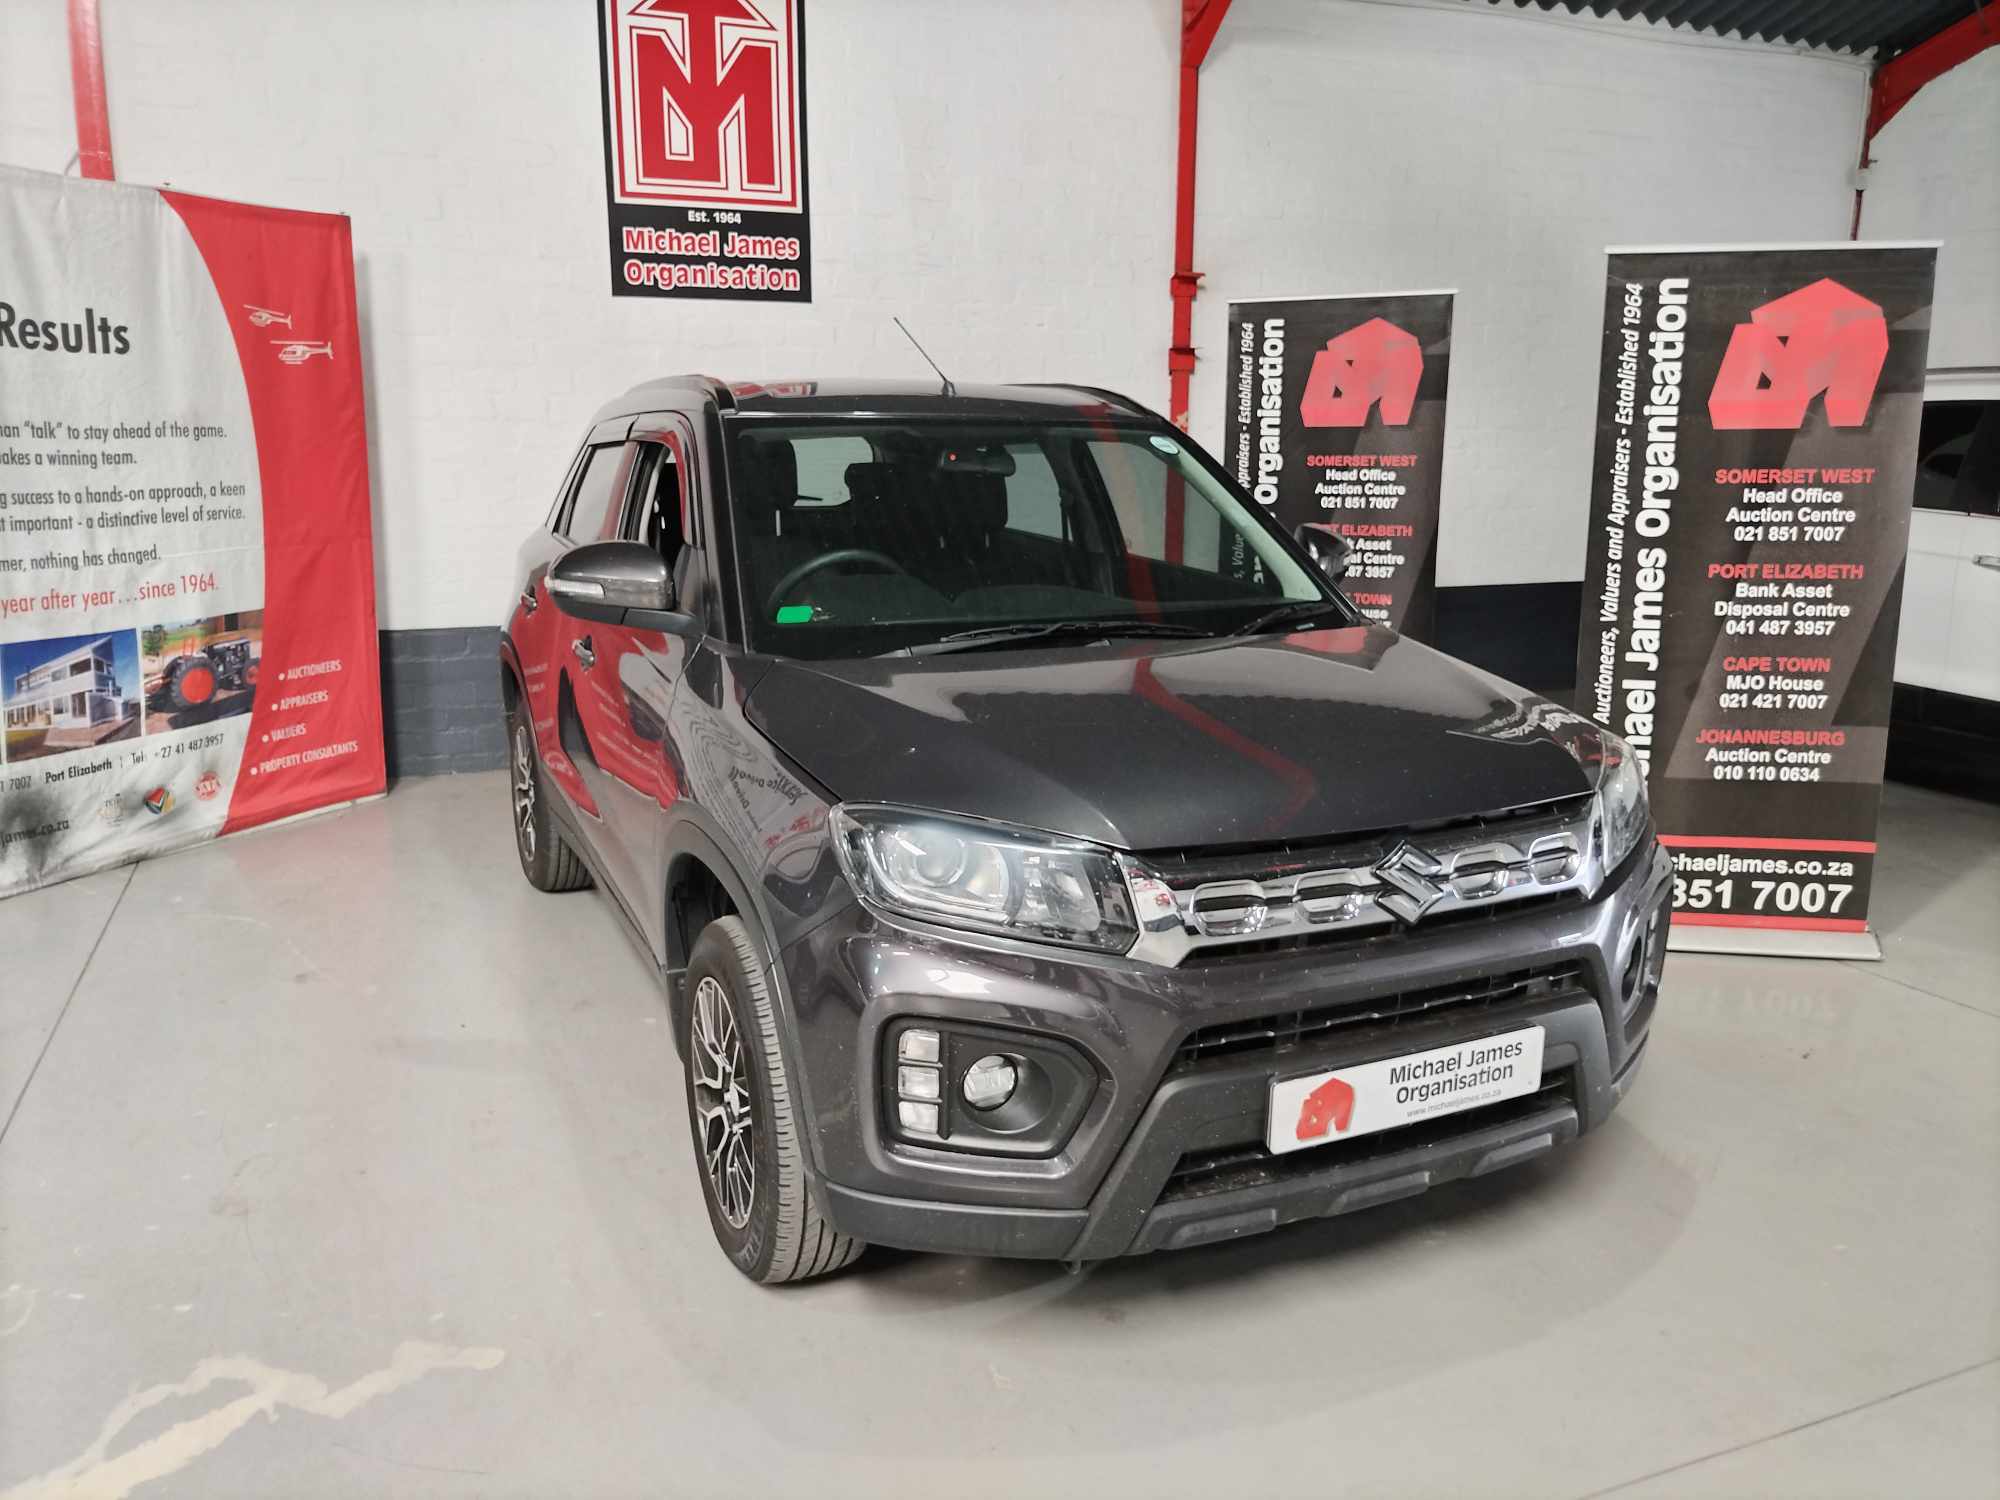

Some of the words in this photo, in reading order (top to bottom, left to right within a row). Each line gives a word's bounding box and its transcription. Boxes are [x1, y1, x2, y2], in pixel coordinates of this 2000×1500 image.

[688, 210, 710, 223] Est.
[713, 212, 742, 225] 1964
[622, 226, 720, 256] Michael
[724, 232, 801, 260] James
[624, 259, 801, 291] Organisation
[1623, 282, 1643, 325] 1964
[0, 302, 130, 354] Results
[1242, 322, 1255, 353] 1964
[1615, 329, 1640, 425] Established
[1238, 354, 1253, 424] Established
[1254, 318, 1286, 505] Organisation
[1635, 278, 1690, 538] Organisation
[67, 425, 80, 439] to
[84, 425, 109, 443] stay
[113, 421, 151, 439] ahead
[155, 420, 166, 438] of
[170, 421, 190, 438] the
[193, 426, 228, 441] game.
[0, 448, 31, 465] akes
[35, 453, 43, 465] a
[47, 449, 98, 469] winning
[101, 451, 137, 465] team.
[1236, 432, 1251, 489] ppraisers
[1306, 454, 1377, 467] SOMERSET
[1380, 454, 1418, 467] WEST
[1326, 468, 1358, 481] Head
[1359, 468, 1397, 481] Office
[1607, 437, 1631, 526] Appraisers
[1715, 469, 1817, 484] SOMERSET
[1822, 468, 1875, 484] WEST
[11, 491, 54, 505] success
[58, 490, 71, 504] to
[75, 492, 82, 504] a
[86, 484, 145, 503] hands-on
[149, 481, 206, 503] approach,
[210, 486, 217, 497] a
[220, 480, 246, 496] keen
[1315, 482, 1362, 495] Auction
[1364, 483, 1406, 496] Centre
[1743, 488, 1787, 503] Head
[1791, 488, 1843, 503] Office
[1320, 496, 1342, 509] 021
[1368, 497, 1399, 509] 7007
[10, 515, 73, 535] important
[86, 517, 93, 529] a
[97, 510, 158, 528] distinctive
[161, 506, 189, 523] level
[193, 505, 203, 522] of
[206, 507, 245, 520] service.
[1725, 507, 1793, 523] Auction
[1798, 507, 1857, 523] Centre
[1341, 524, 1413, 537] ELIZABETH
[1734, 526, 1763, 542] 021
[1768, 526, 1798, 542] 851
[1804, 526, 1845, 542] 7007
[1356, 538, 1392, 551] Asset
[1605, 526, 1624, 560] and
[30, 552, 79, 571] nothing
[83, 550, 104, 567] has
[107, 544, 161, 566] changed.
[1363, 552, 1405, 565] Centre
[1708, 564, 1758, 579] PORT
[1762, 564, 1864, 579] ELIZABETH
[0, 597, 35, 619] year
[41, 588, 76, 610] after
[180, 573, 219, 594] 1964.
[1353, 592, 1392, 606] TOWN
[1600, 562, 1621, 622] Valuers
[1735, 582, 1780, 598] Bank
[1781, 583, 1833, 598] Asset
[1625, 547, 1667, 671] James
[1714, 601, 1789, 619] Disposal
[1792, 602, 1850, 617] Centre
[1725, 620, 1754, 635] 041
[1759, 620, 1790, 635] 487
[1794, 620, 1835, 635] 3957
[1593, 627, 1620, 725] Auctioneers,
[1723, 656, 1772, 672] CAPE
[1776, 657, 1831, 673] TOWN
[1726, 675, 1766, 690] MJO
[1768, 676, 1824, 691] House
[1719, 693, 1748, 708] 021
[1752, 694, 1782, 708] 421
[1787, 694, 1828, 709] 7007
[1696, 729, 1846, 745] JOHANNESBURG
[1705, 747, 1770, 763] Auction
[1775, 749, 1832, 764] Centre
[45, 771, 65, 784] Port
[68, 758, 112, 778] Elizabeth
[1713, 765, 1743, 780] 010
[1748, 766, 1776, 781] 110
[1779, 766, 1820, 782] 0634
[1670, 853, 1854, 876] chaeljames.co.za
[1751, 880, 1853, 914] 7007
[1390, 1052, 1462, 1085] Michael
[1466, 1041, 1523, 1067] James
[1396, 1064, 1513, 1104] Organisation
